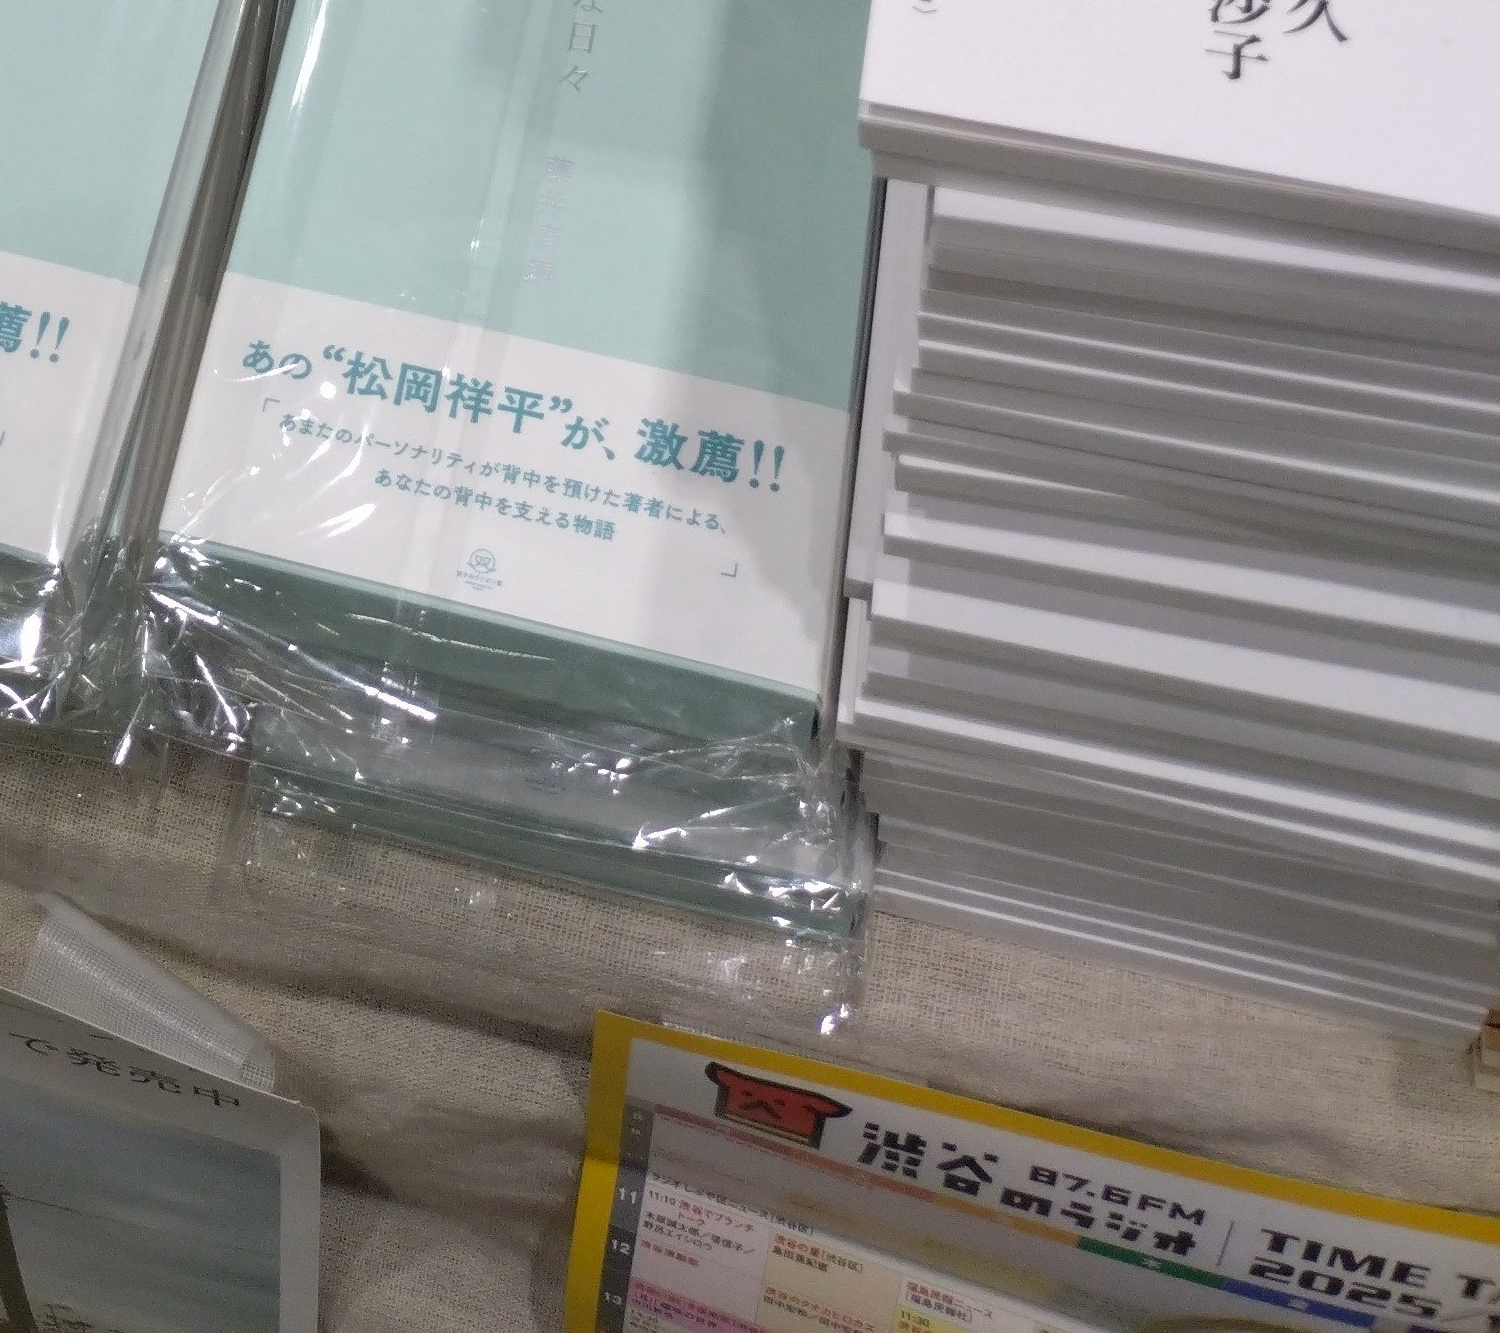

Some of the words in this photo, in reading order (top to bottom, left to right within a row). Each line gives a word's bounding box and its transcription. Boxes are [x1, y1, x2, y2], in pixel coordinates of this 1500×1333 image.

[856, 1123, 1198, 1258] 渋谷のラジオ
[1029, 1164, 1206, 1227] 87.6FM
[1260, 1227, 1432, 1288] TIME
